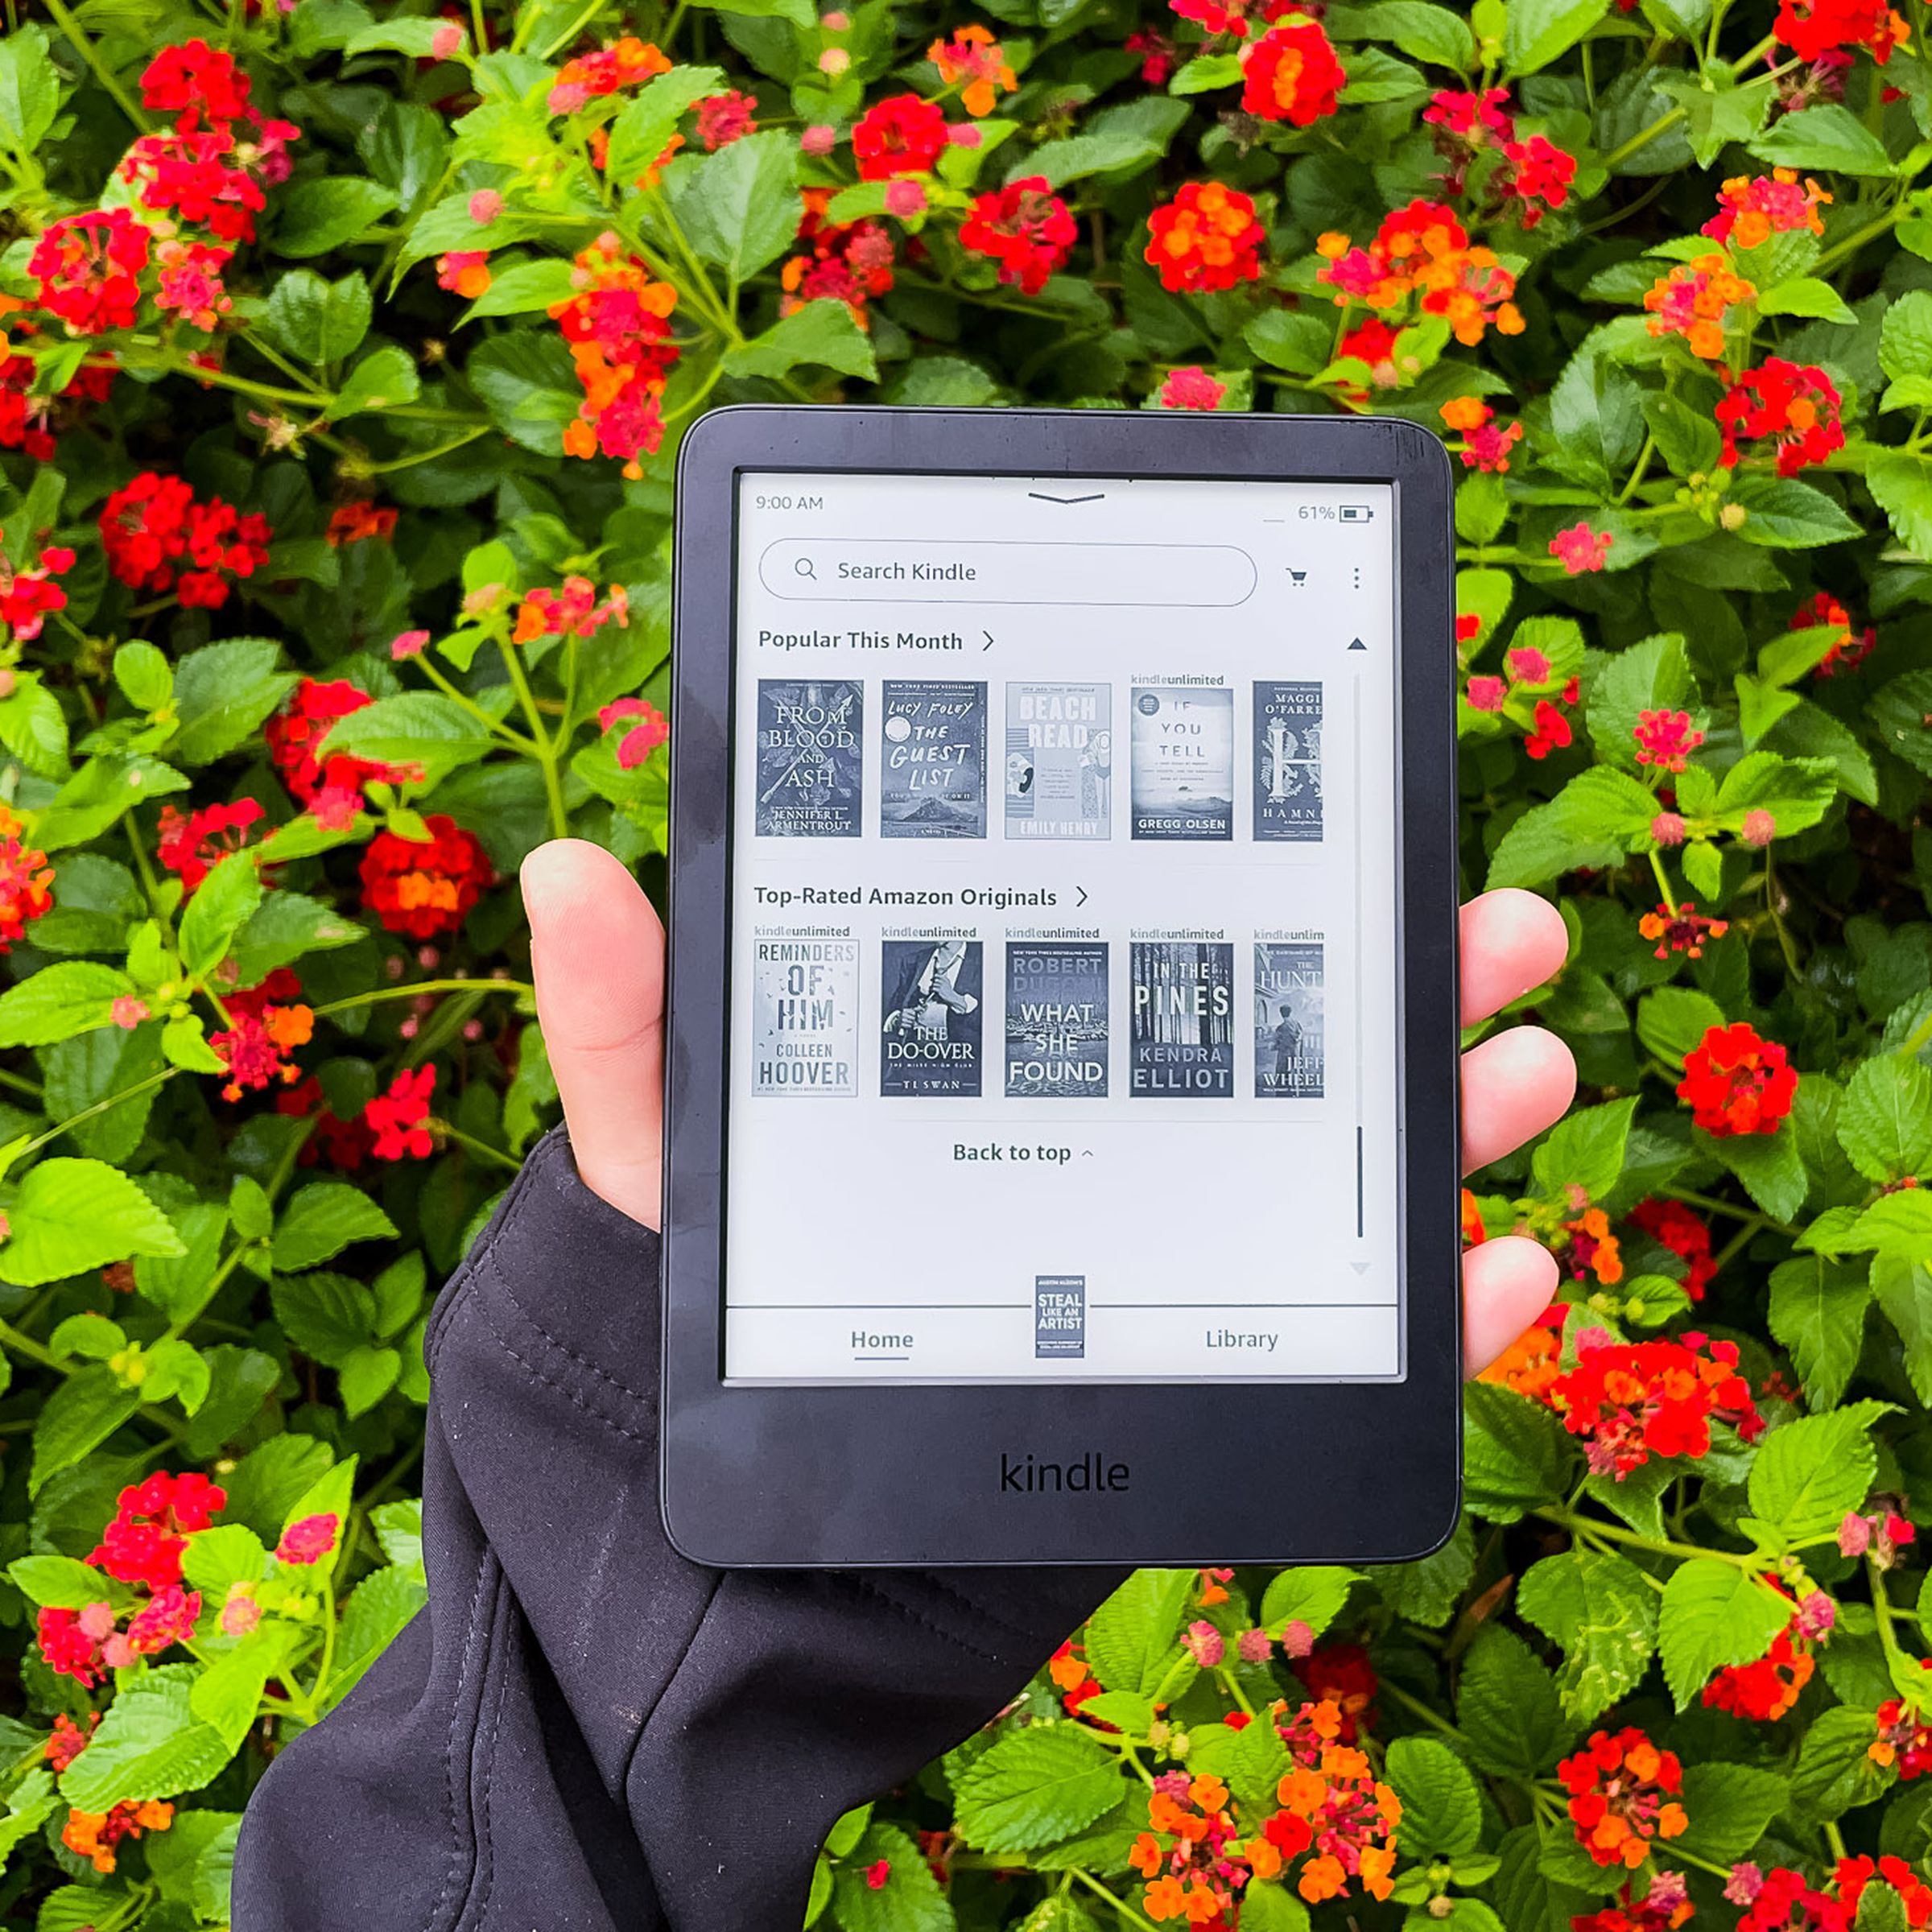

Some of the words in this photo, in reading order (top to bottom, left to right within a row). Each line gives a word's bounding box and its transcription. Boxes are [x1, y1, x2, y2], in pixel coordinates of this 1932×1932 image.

[756, 496, 791, 510] 9:00
[797, 497, 824, 510] AM
[1298, 506, 1335, 519] 61%
[838, 563, 905, 580] Search
[912, 563, 976, 580] Kindle
[758, 630, 841, 651] Popular
[847, 632, 890, 649] This
[897, 633, 963, 650] Month
[1131, 674, 1224, 686] kindleunlimited
[888, 700, 921, 716] LUCY
[927, 702, 973, 720] FOLEY
[1019, 696, 1096, 721] BEACH
[1174, 701, 1191, 711] IF
[777, 705, 846, 725] FROM
[913, 725, 949, 741] THE
[1028, 724, 1088, 749] READ
[1161, 723, 1201, 735] YOU
[768, 729, 854, 748] BLOOD
[796, 753, 824, 764] AND
[890, 744, 971, 769] GUEST
[1159, 745, 1205, 758] TELL
[786, 770, 835, 787] ASH
[909, 768, 954, 791] LIST
[773, 811, 832, 819] JENNIFER
[766, 821, 852, 830] ARMENTROUT
[1020, 821, 1057, 835] EMILY
[1138, 819, 1181, 829] GREGG
[1186, 819, 1226, 829] OLSEN
[754, 886, 862, 907] Top-Rated
[869, 888, 953, 905] Amazon
[960, 887, 1057, 910] Originals
[754, 925, 850, 937] kindleunlimited
[881, 927, 977, 938] kindleunlimited
[1005, 927, 1100, 939] kindleunlimited
[1130, 928, 1224, 939] kindleunlimited
[759, 944, 855, 961] REMINDERS
[1013, 958, 1102, 974] ROBERT
[1154, 963, 1170, 978] IN
[1179, 963, 1209, 979] THE
[787, 964, 825, 996] OF
[1134, 985, 1229, 1016] PINES
[778, 999, 834, 1030] HIM
[1021, 1004, 1094, 1022] WHAT
[914, 1026, 947, 1041] THE
[1036, 1034, 1079, 1051] SHE
[776, 1044, 832, 1058] COLLEEN
[888, 1043, 975, 1059] DO-OVER
[1140, 1048, 1222, 1062] KENDRA
[760, 1062, 849, 1084] HOOVER
[1009, 1061, 1103, 1082] FOUND
[1133, 1069, 1229, 1088] ELLIOT
[923, 1081, 960, 1089] SWAN
[953, 1143, 1003, 1161] Back
[1009, 1146, 1031, 1161] to
[1037, 1146, 1071, 1166] top
[1038, 1294, 1082, 1307] STEAL
[1042, 1308, 1062, 1316] LIKE
[1038, 1318, 1082, 1329] ARTIST
[851, 1331, 914, 1349] Home
[1206, 1330, 1279, 1352] Library
[1000, 1452, 1130, 1492] kindle
